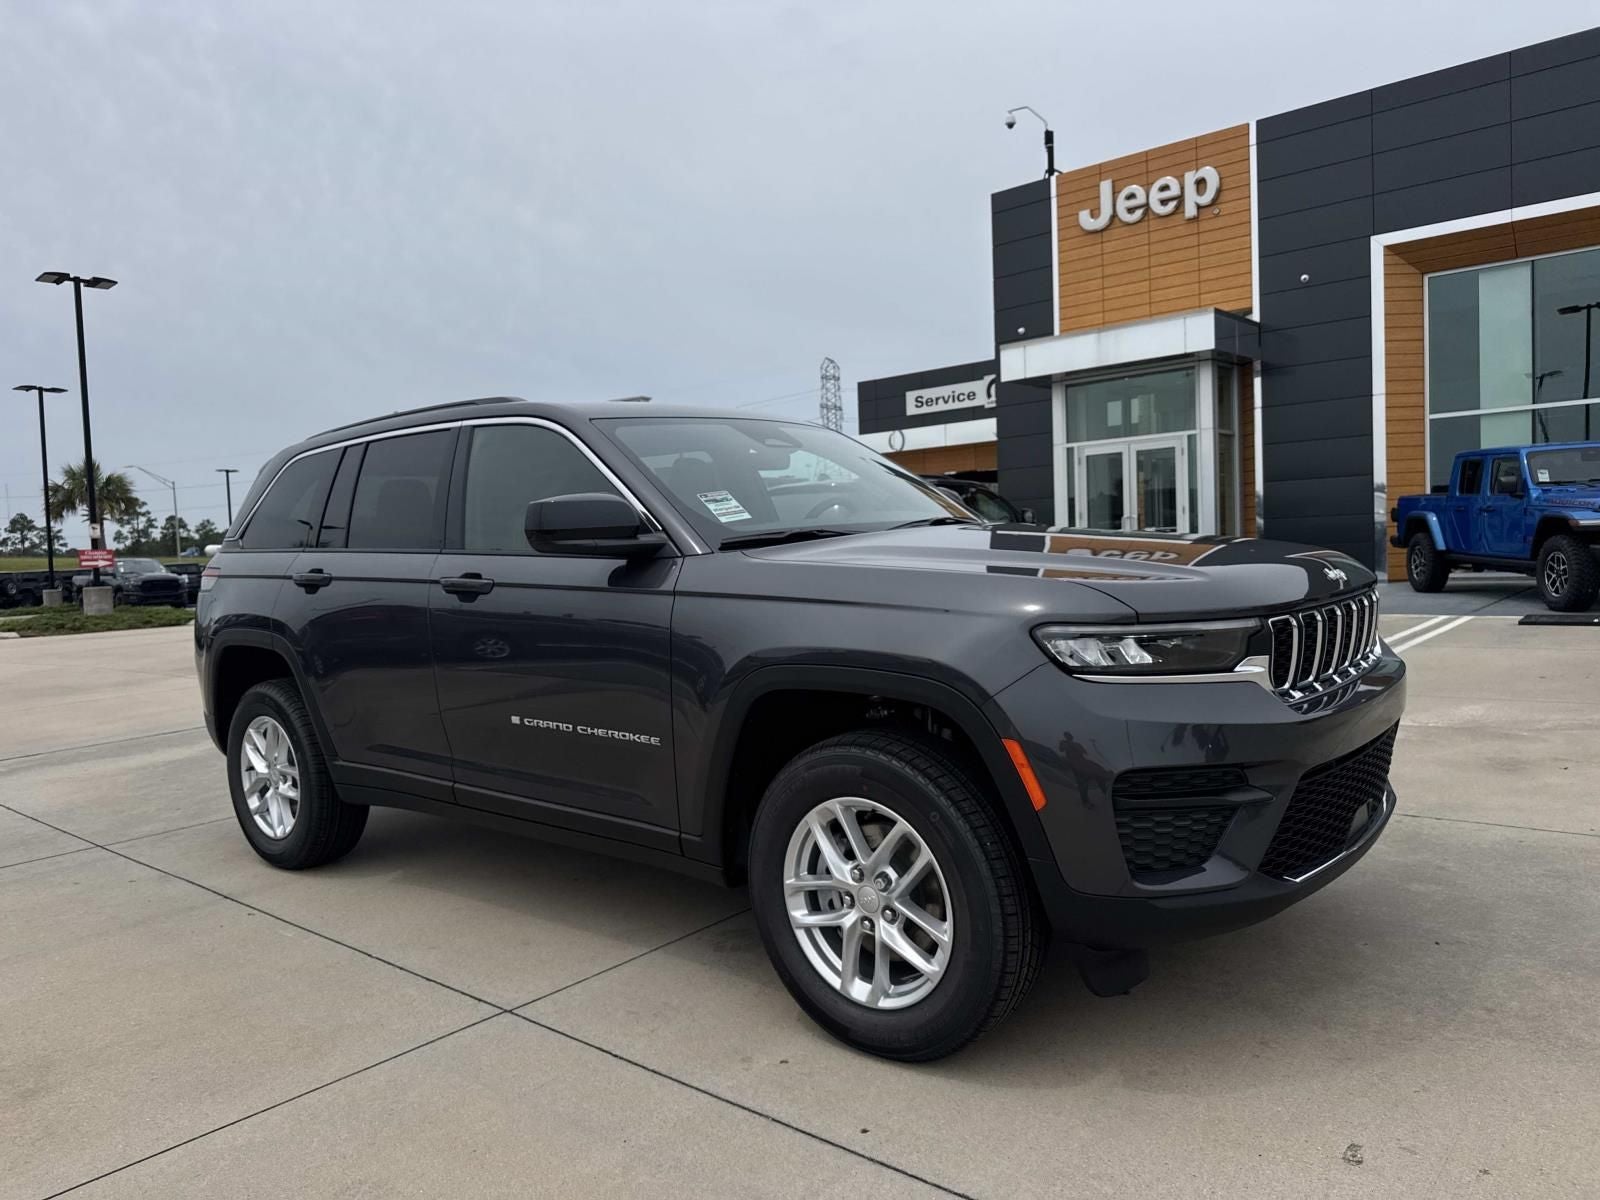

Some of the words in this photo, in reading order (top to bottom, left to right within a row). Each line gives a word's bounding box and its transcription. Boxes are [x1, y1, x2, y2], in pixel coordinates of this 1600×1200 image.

[1078, 165, 1220, 233] Jeep
[914, 390, 976, 408] Service
[523, 718, 573, 732] GRAND
[577, 725, 661, 746] CHEROKEE
